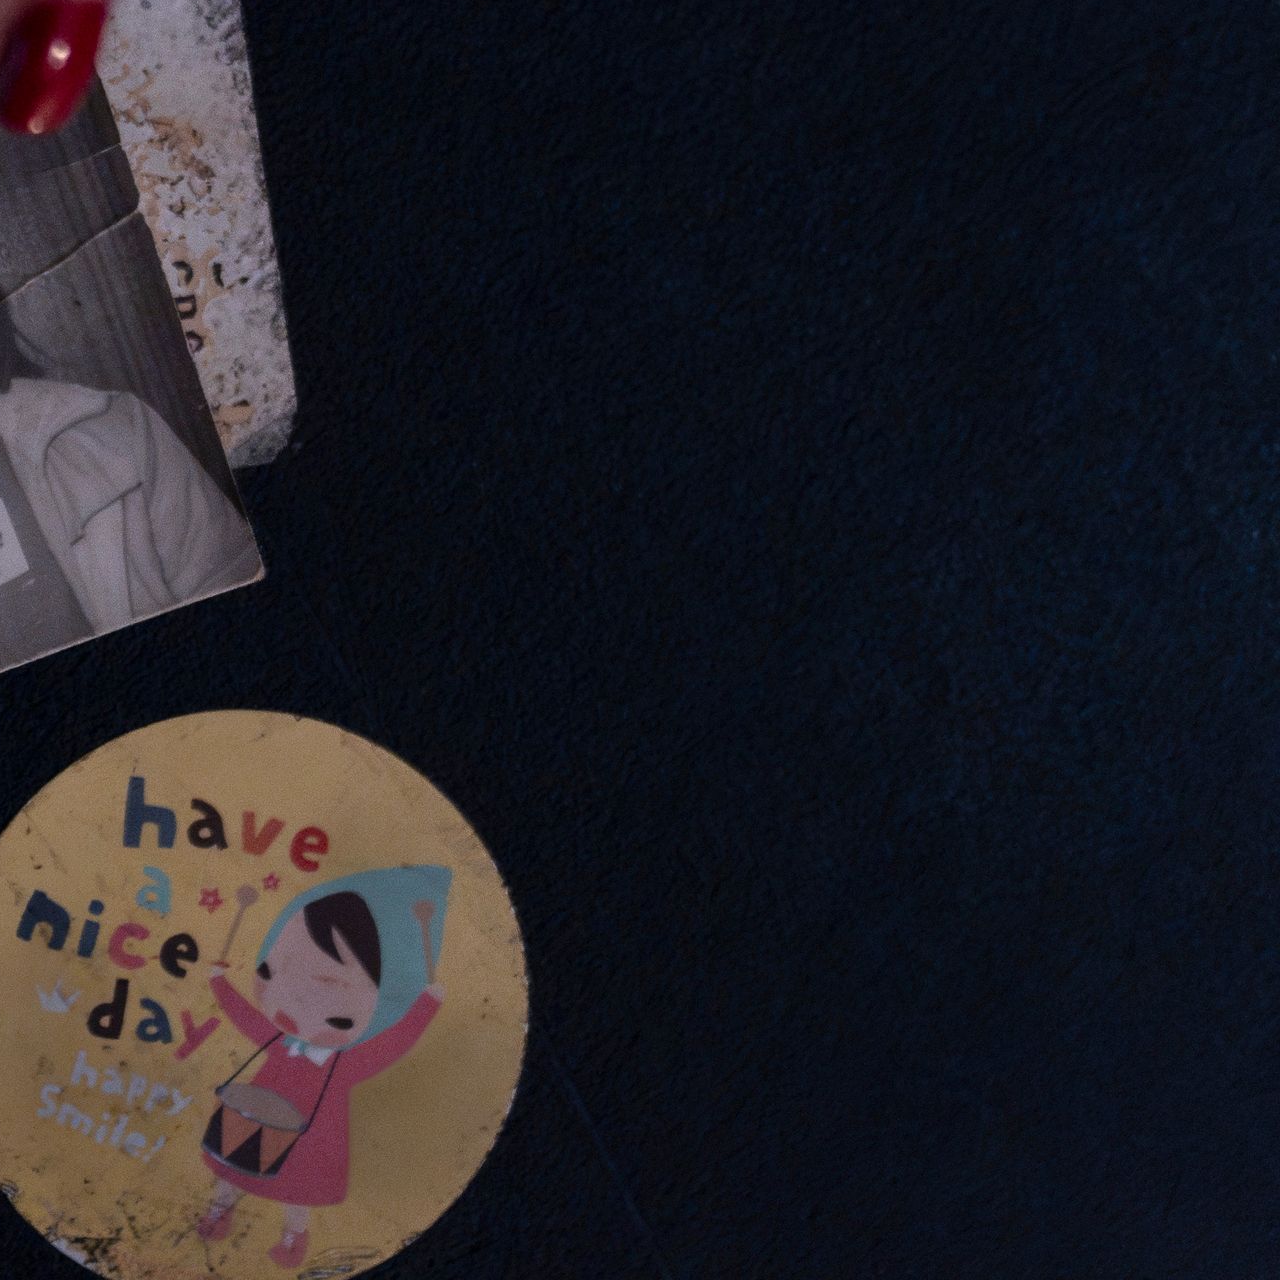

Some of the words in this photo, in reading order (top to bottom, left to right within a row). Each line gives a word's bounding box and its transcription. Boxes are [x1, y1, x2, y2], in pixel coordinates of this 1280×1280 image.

[123, 776, 329, 872] have
[136, 866, 172, 914] a
[16, 889, 199, 979] nice
[86, 978, 221, 1060] day
[71, 1050, 192, 1116] happy
